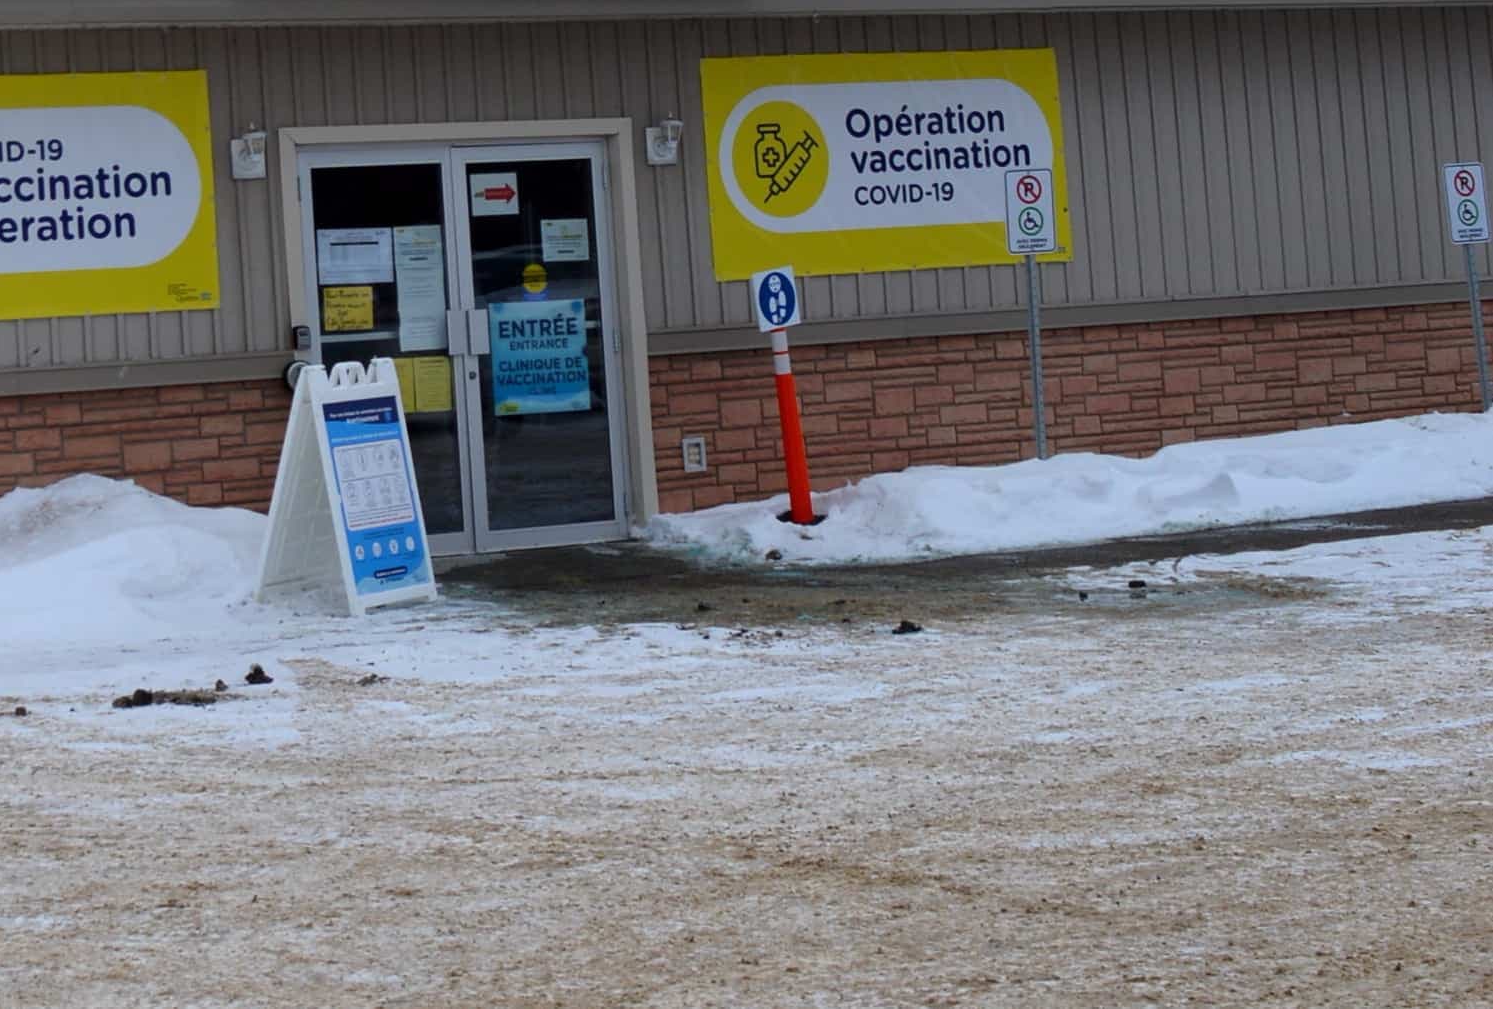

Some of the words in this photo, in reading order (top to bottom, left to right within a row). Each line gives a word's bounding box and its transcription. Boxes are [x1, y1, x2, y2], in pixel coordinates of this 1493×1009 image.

[845, 103, 1005, 144] Opération
[850, 138, 1031, 175] vaccination
[853, 181, 956, 207] COVID-19
[498, 313, 579, 339] ENTRÉE
[509, 337, 569, 351] ENTRANCE
[499, 358, 561, 373] CLINIQUE
[564, 356, 583, 368] DE
[497, 370, 587, 387] VACCINATION
